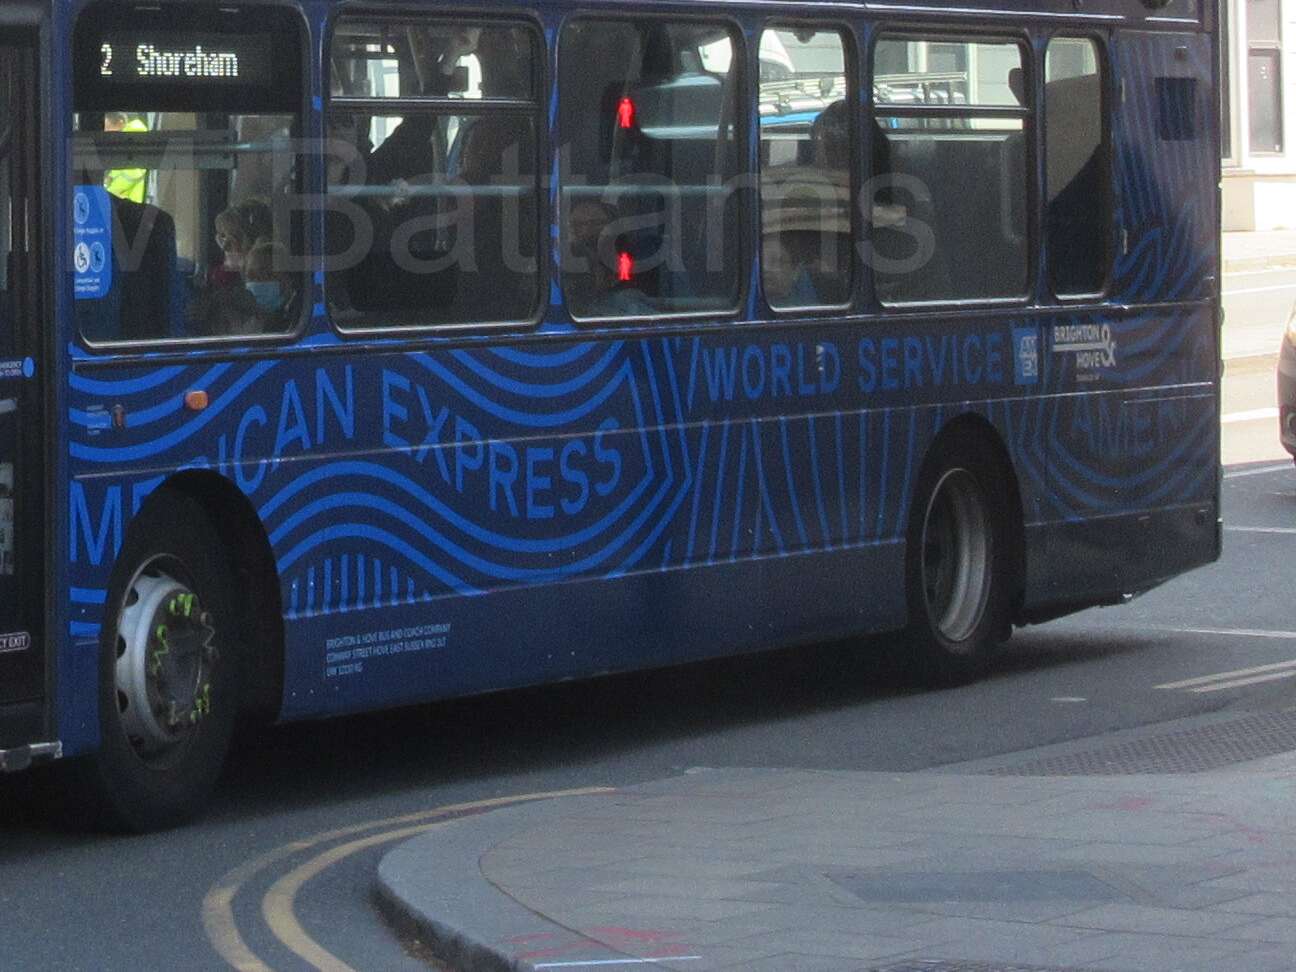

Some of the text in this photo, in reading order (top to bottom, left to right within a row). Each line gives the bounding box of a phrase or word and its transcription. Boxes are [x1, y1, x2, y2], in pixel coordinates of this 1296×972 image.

[101, 44, 238, 76] 2 Shoreham
[1053, 323, 1100, 344] BRIGHTON
[704, 333, 1005, 402] WORLD SERVICE
[1076, 351, 1100, 369] HOVE
[383, 369, 621, 519] EXPRESS
[8, 636, 26, 648] EXIT
